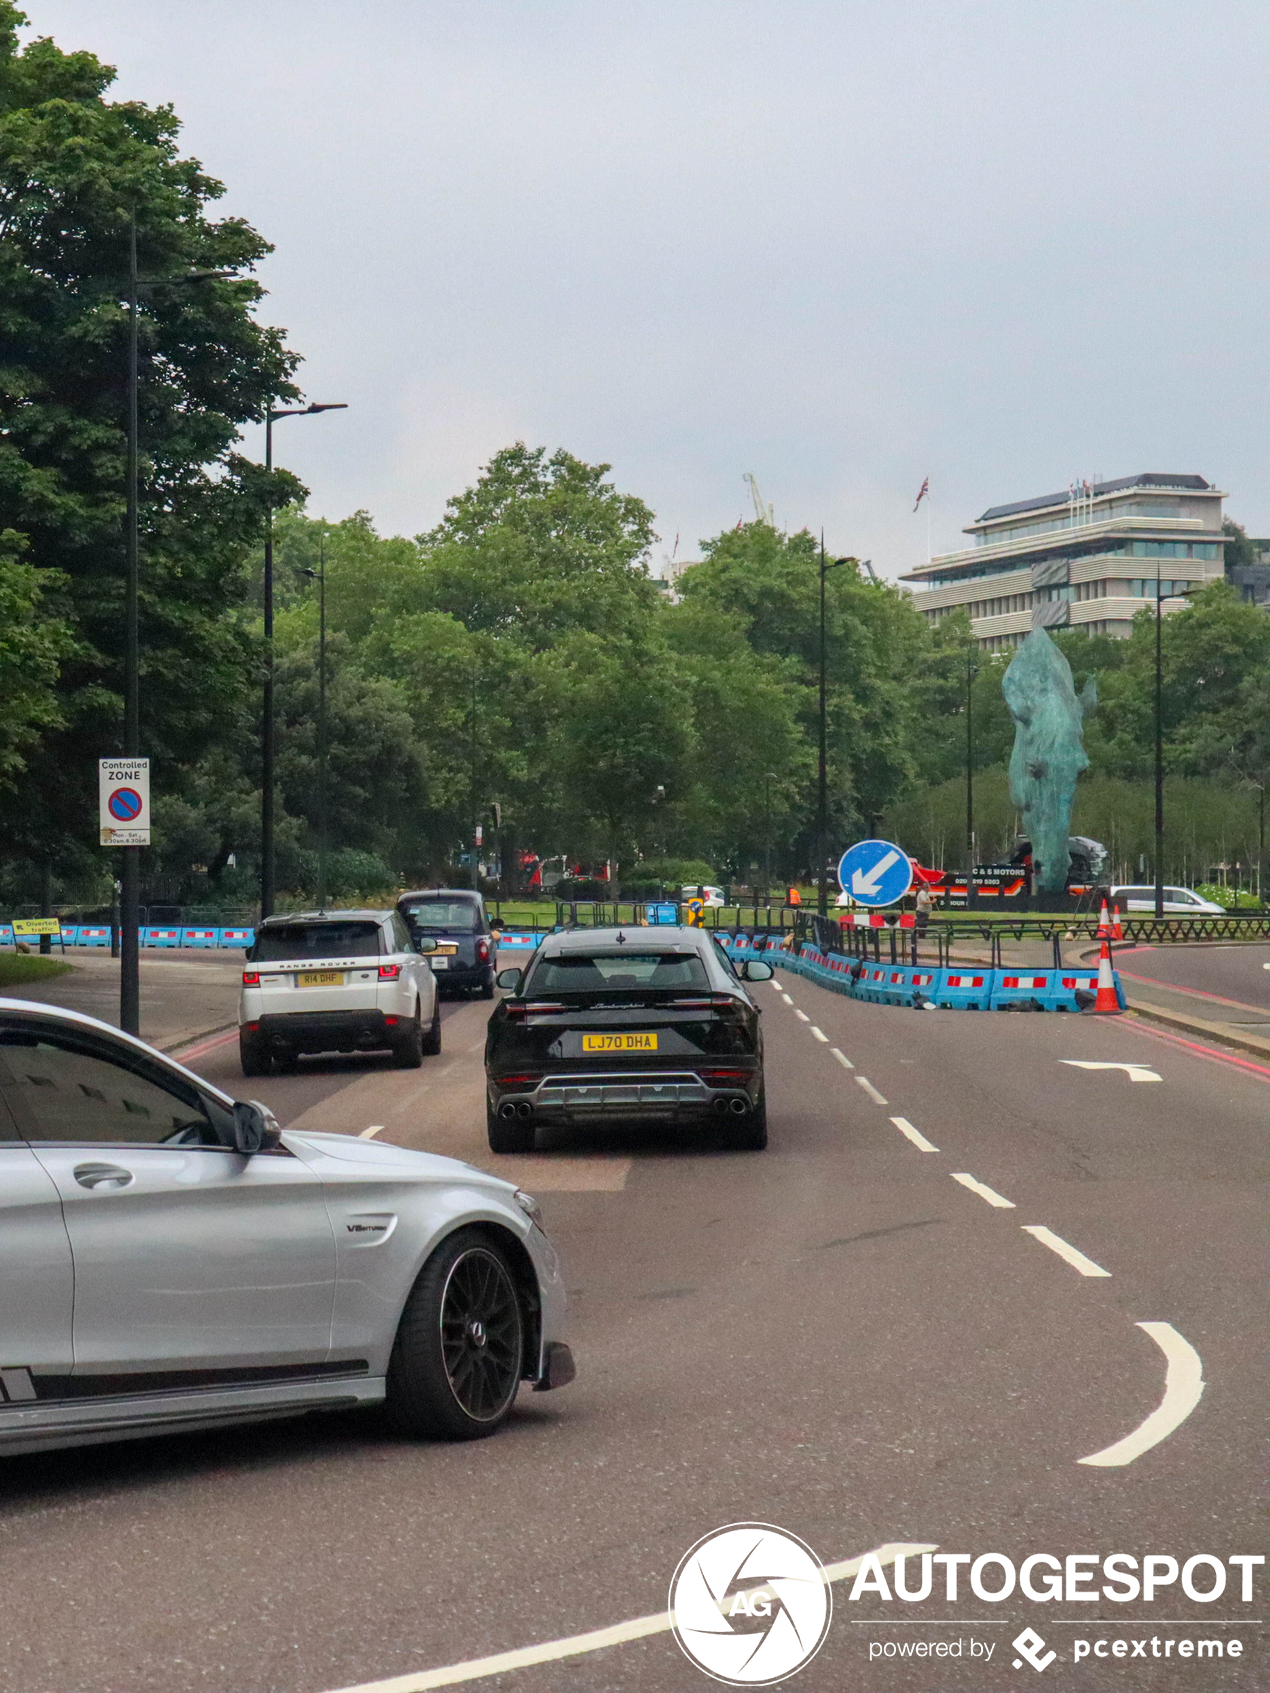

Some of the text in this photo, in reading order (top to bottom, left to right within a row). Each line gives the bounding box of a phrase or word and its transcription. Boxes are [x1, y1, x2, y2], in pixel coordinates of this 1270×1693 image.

[108, 771, 141, 780] ZONE
[320, 973, 336, 983] DHF
[588, 1036, 651, 1049] LJ70 DHA
